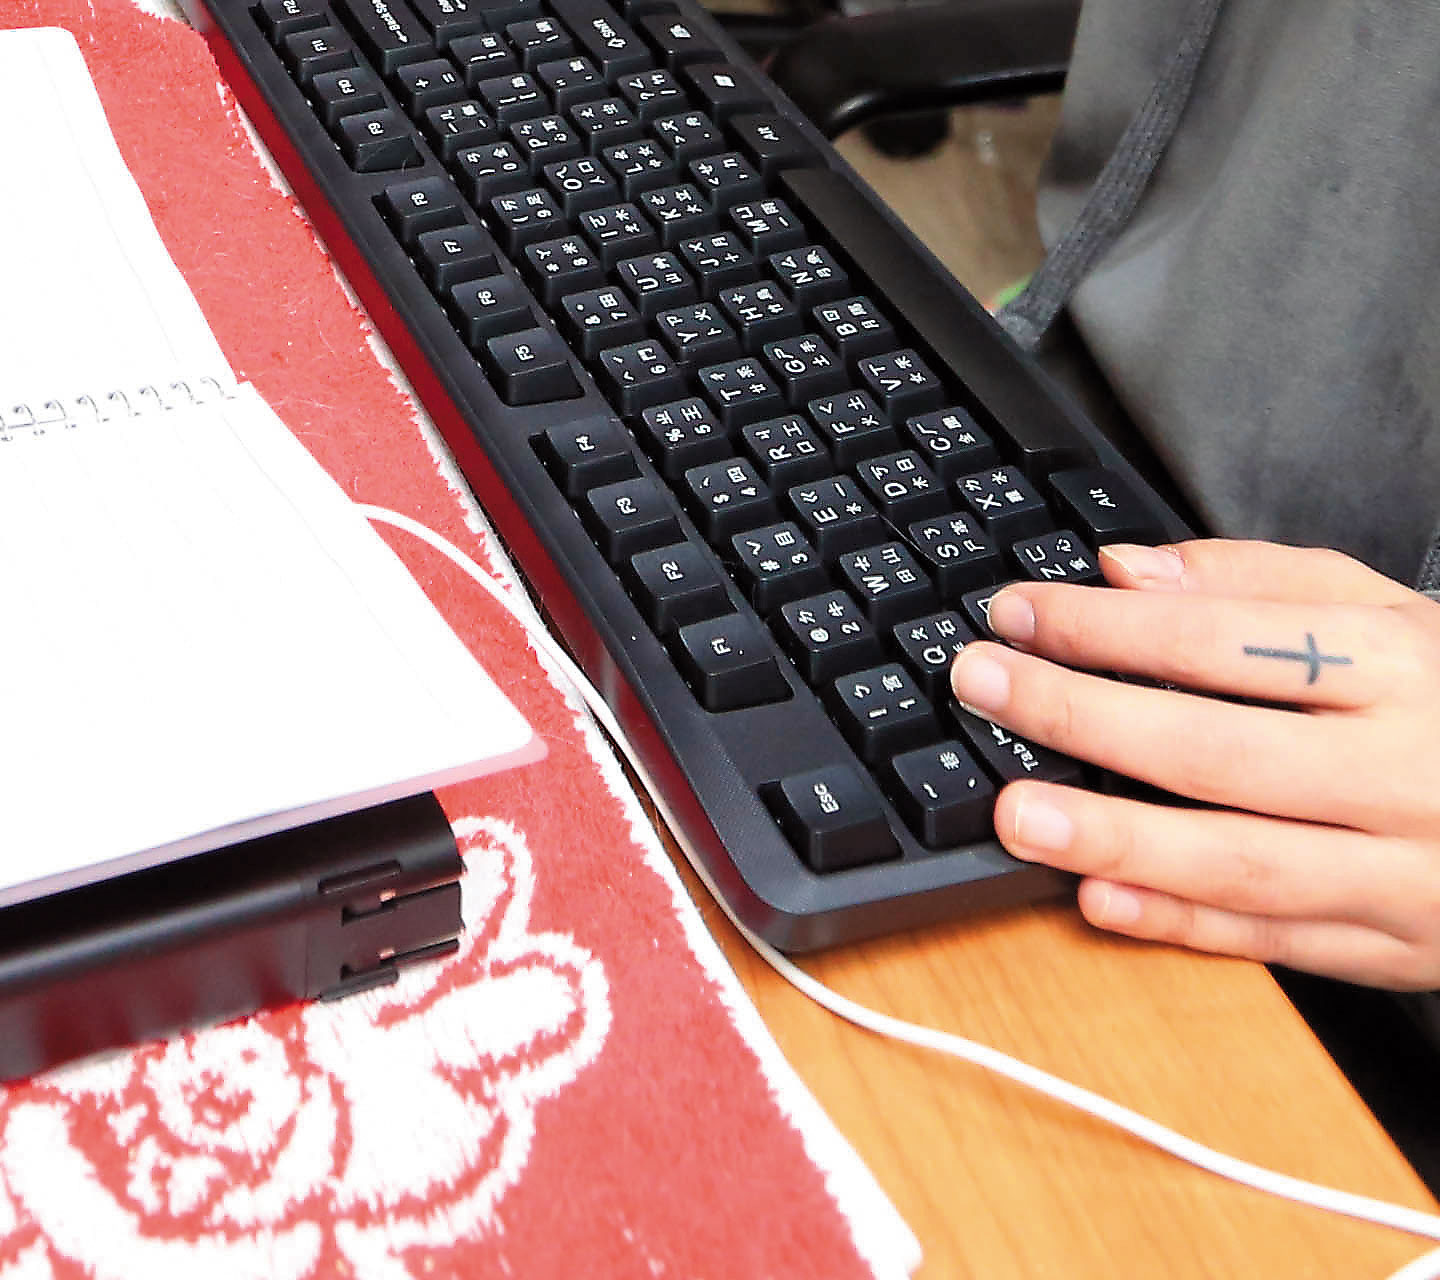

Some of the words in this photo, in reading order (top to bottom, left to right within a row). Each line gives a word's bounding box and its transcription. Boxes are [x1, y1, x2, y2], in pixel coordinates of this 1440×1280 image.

[283, 0, 301, 14] F12
[338, 79, 355, 94] F10
[367, 122, 384, 135] F9
[528, 138, 548, 148] P
[502, 162, 517, 171] 0
[626, 163, 644, 175] L
[561, 176, 583, 190] O
[411, 192, 428, 206] F8
[536, 209, 552, 218] 9
[659, 208, 682, 220] K
[746, 219, 770, 233] M
[443, 240, 462, 253] F7
[561, 240, 579, 255] 米
[535, 248, 553, 260] ㄚ
[572, 257, 588, 266] 8
[700, 258, 720, 267] J
[636, 277, 661, 292] U
[790, 271, 814, 284] N
[477, 290, 496, 305] F6
[598, 293, 618, 308] 田
[610, 312, 627, 320] 7
[694, 305, 712, 321] 火
[739, 306, 764, 321] H
[666, 315, 684, 327] ㄗ
[836, 323, 858, 336] B
[676, 332, 699, 343] Y
[514, 343, 535, 361] F5
[650, 364, 666, 374] 6
[784, 359, 806, 373] G
[868, 364, 886, 377] ㄒ
[879, 379, 902, 391] V
[720, 389, 742, 401] T
[680, 404, 703, 422] 王
[818, 402, 833, 414] ㄑ
[655, 410, 674, 425] ㄓ
[694, 423, 711, 434] 5
[782, 420, 803, 437] 工
[834, 422, 856, 434] F
[916, 423, 939, 436] ㄏ
[575, 435, 595, 452] F4
[796, 440, 816, 454] 口
[929, 437, 951, 451] C
[768, 444, 792, 461] R
[895, 457, 916, 472] 日
[883, 482, 908, 497] D
[911, 476, 929, 490] 木
[740, 487, 756, 496] 4
[1089, 488, 1116, 508] Alt
[615, 497, 637, 514] F3
[975, 493, 1002, 511] X
[812, 507, 839, 523] E
[774, 530, 796, 547] 目
[937, 544, 960, 558] S
[791, 553, 808, 564] 3
[662, 559, 684, 581] F2
[895, 567, 917, 583] 田
[1039, 563, 1067, 579] Z
[862, 575, 890, 594] W
[841, 621, 861, 634] 2
[710, 637, 731, 655] F1
[923, 644, 947, 664] Q
[899, 698, 916, 710] 1
[1013, 743, 1039, 772] Tab
